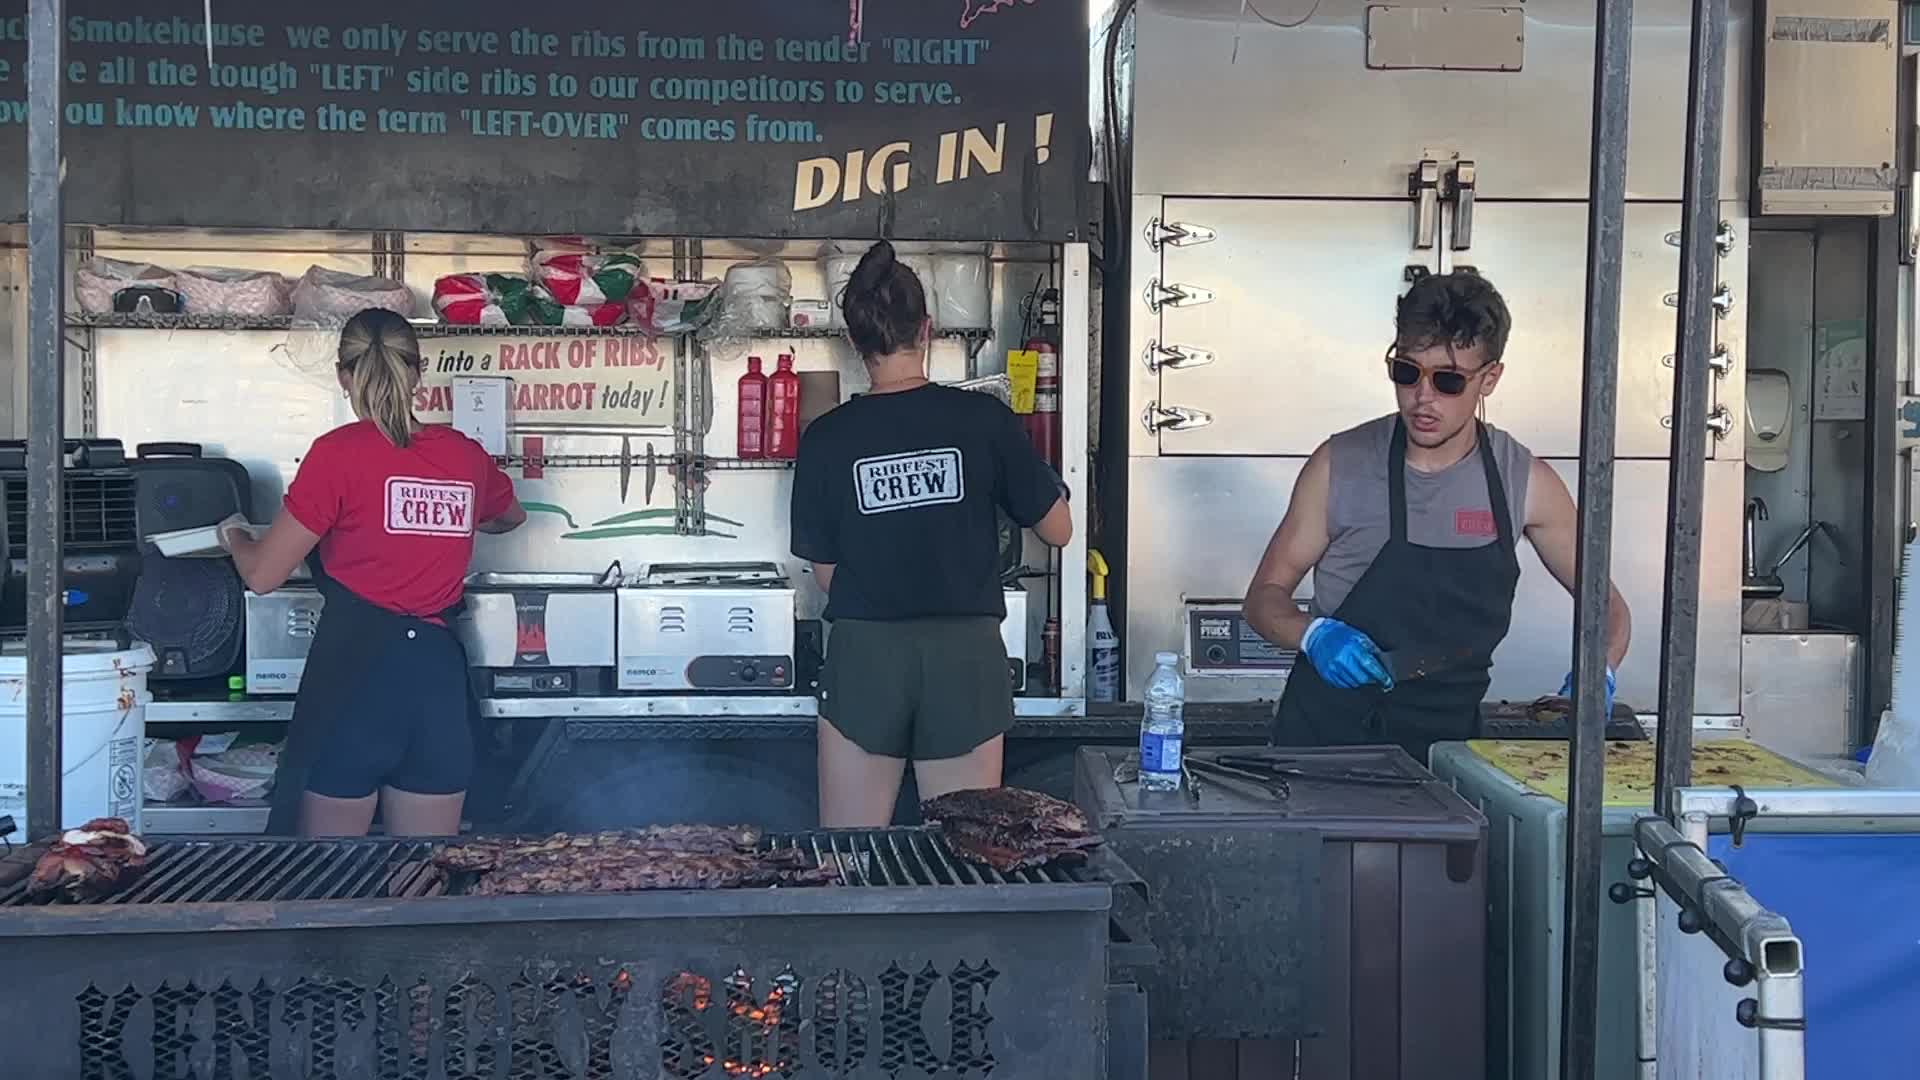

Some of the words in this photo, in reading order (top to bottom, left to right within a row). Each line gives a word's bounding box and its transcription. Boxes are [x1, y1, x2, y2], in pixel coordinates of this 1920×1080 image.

[69, 16, 265, 47] Smokehouse
[287, 25, 329, 49] we
[342, 23, 405, 56] only
[417, 32, 498, 54] serve
[510, 28, 559, 56] the
[571, 30, 626, 59] ribs
[637, 32, 704, 61] from
[716, 33, 764, 62] the
[775, 35, 872, 64] tender
[882, 37, 990, 65] "RIGHT"
[99, 56, 136, 84] all
[147, 58, 197, 87] the
[209, 62, 296, 95] tough
[309, 63, 395, 92] "LEFT"
[407, 67, 469, 94] side
[481, 68, 536, 97] ribs
[549, 73, 577, 98] to
[590, 76, 639, 99] our
[650, 74, 825, 105] competitors
[835, 79, 864, 103] to
[875, 82, 963, 105] serve.
[115, 99, 199, 128] know
[209, 100, 305, 130] where
[317, 103, 366, 132] the
[378, 107, 447, 135] term
[460, 109, 629, 140] "LEFT-OVER"
[641, 117, 736, 142] comes
[745, 115, 824, 143] from.
[793, 142, 912, 212] DIG
[935, 122, 1006, 184] IN
[437, 350, 474, 372] into
[480, 353, 492, 370] a
[499, 343, 561, 371] RACK
[567, 340, 597, 369] OF
[604, 338, 665, 371] RIBS,
[512, 383, 596, 411] ARROT
[602, 381, 656, 416] today
[869, 458, 948, 478] RIBFEST
[400, 486, 468, 502] RIBFEST
[873, 470, 947, 502] CREW
[402, 500, 466, 526] CREW
[75, 966, 632, 1080] KENTUCKY
[656, 959, 1000, 1080] SMOKE
